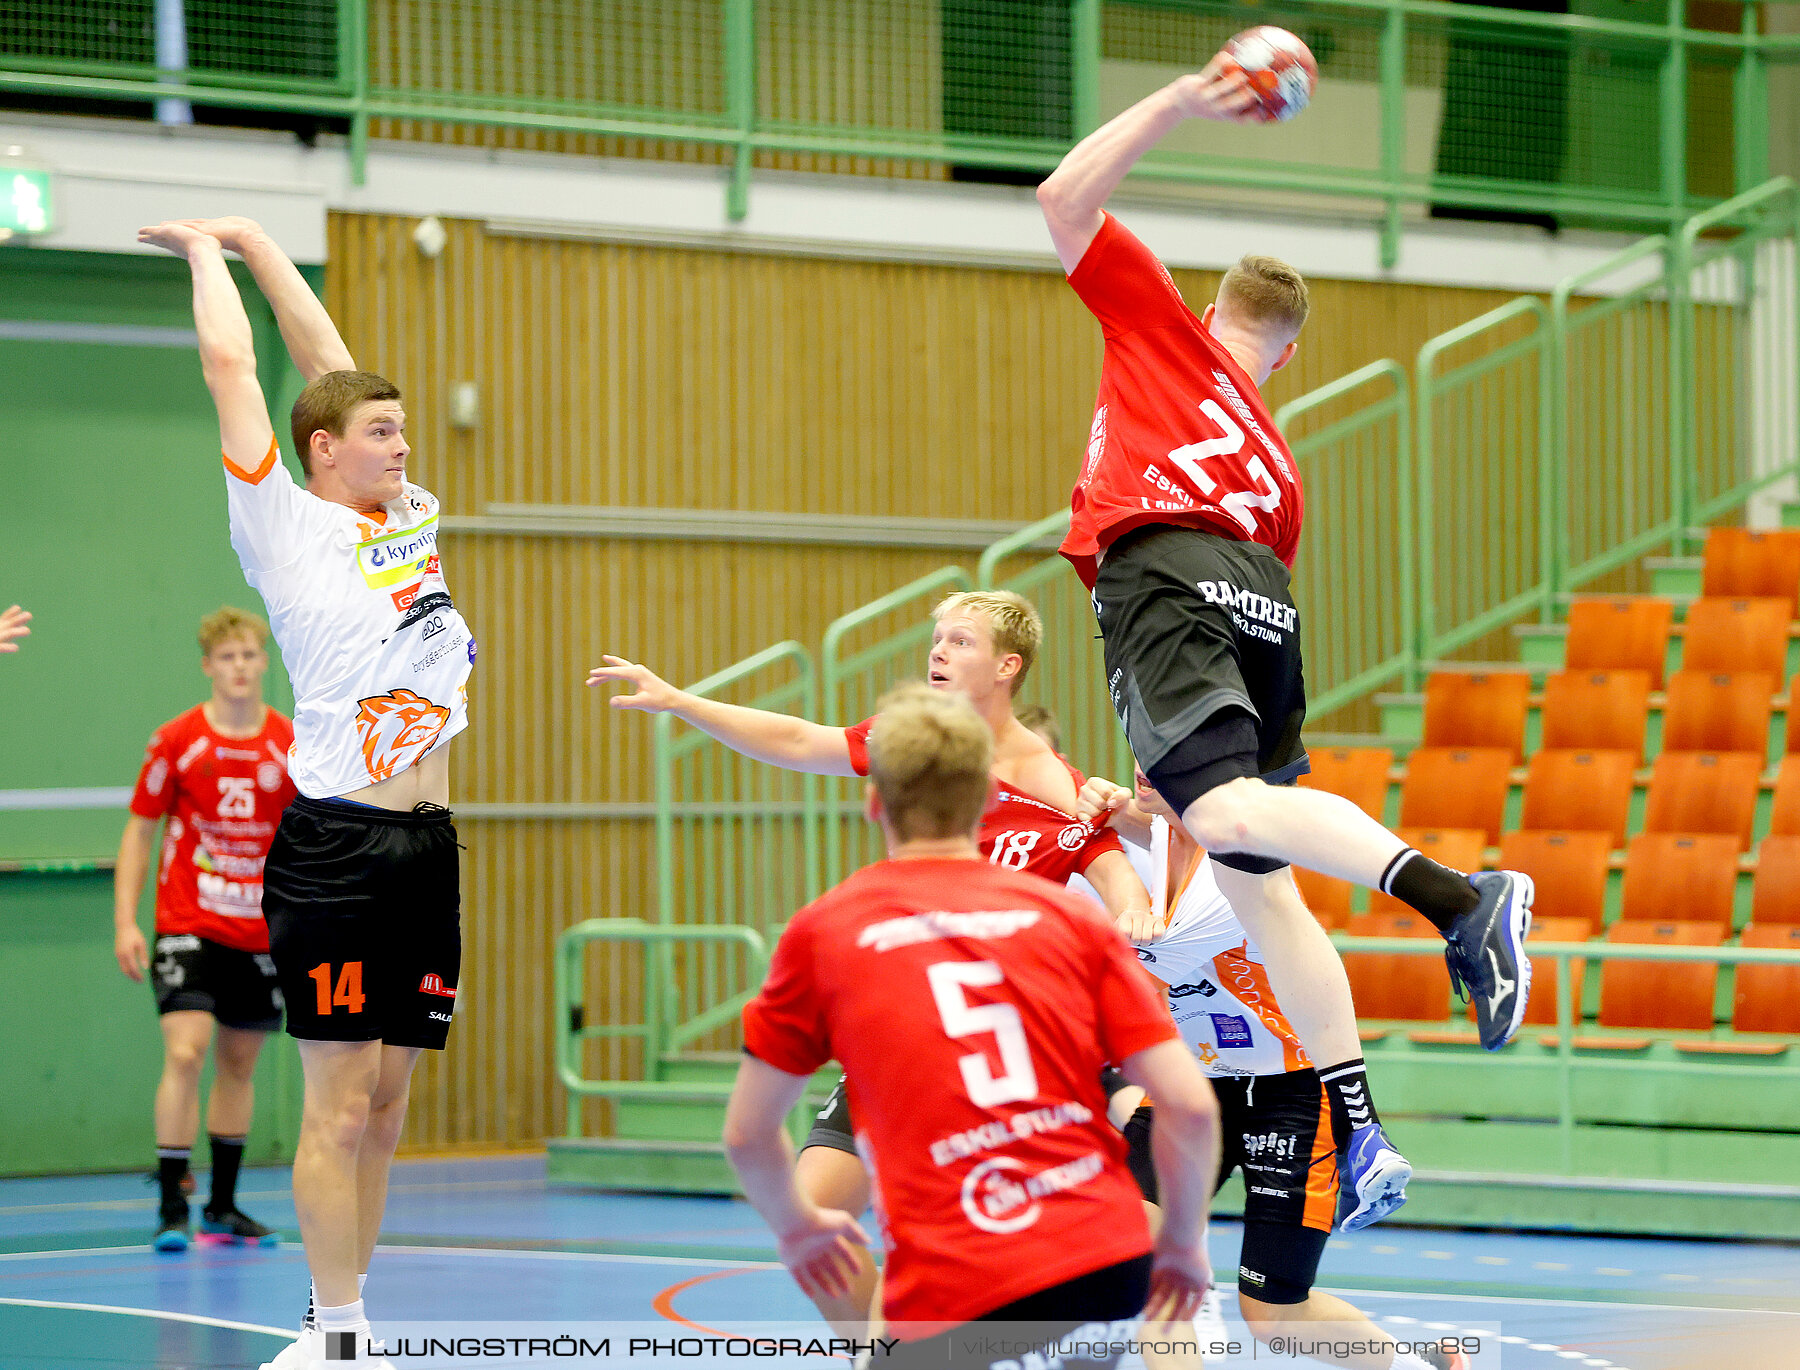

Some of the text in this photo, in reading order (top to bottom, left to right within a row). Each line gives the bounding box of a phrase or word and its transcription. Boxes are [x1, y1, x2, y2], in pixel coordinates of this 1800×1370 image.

[1168, 398, 1281, 536] 22
[217, 776, 255, 818] 25
[989, 830, 1042, 872] 18
[308, 961, 366, 1015] 14
[927, 960, 1038, 1108] 5
